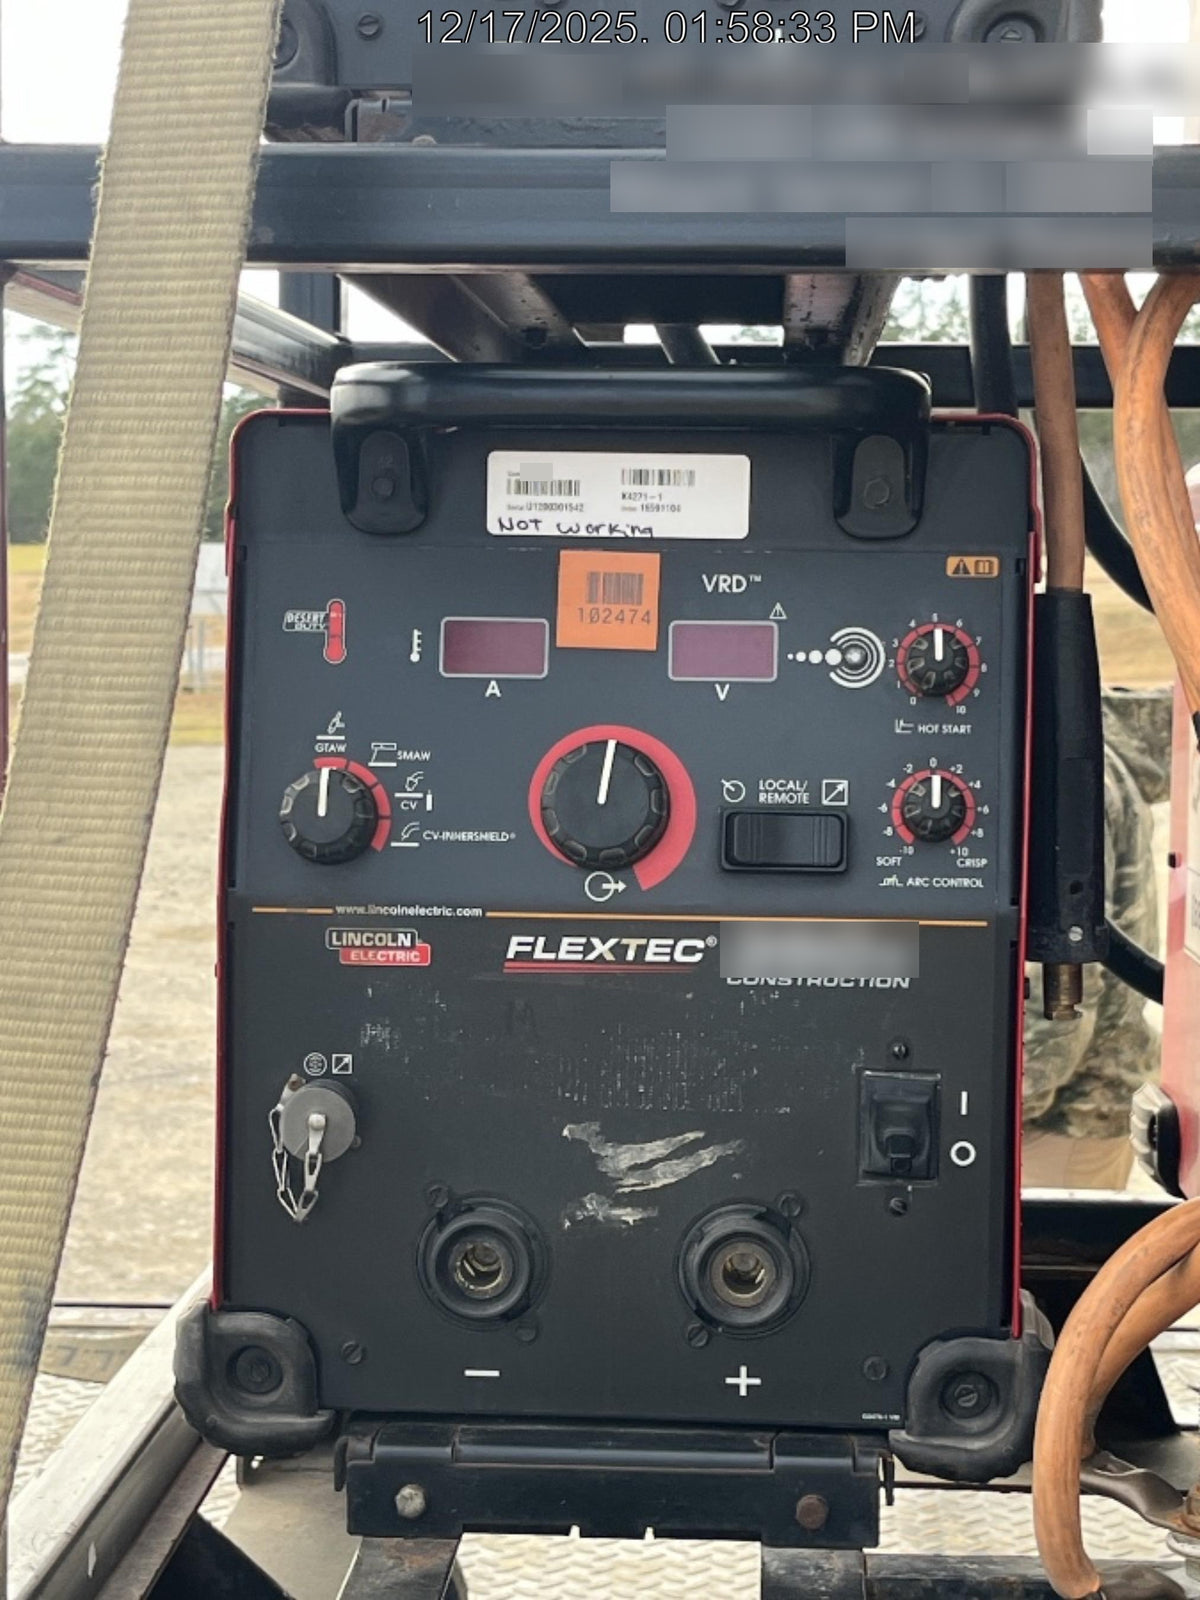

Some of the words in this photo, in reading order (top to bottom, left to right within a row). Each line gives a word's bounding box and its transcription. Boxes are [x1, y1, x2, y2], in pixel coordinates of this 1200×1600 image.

[287, 612, 325, 623] DESERT
[577, 607, 651, 624] 102474
[931, 612, 939, 623] 5
[294, 622, 326, 631] DUTY
[908, 618, 917, 629] 4
[955, 618, 964, 629] 6
[891, 638, 899, 648] 3
[975, 636, 983, 646] 7
[888, 658, 896, 669] 2
[980, 662, 989, 673] 8
[484, 680, 502, 698] A
[714, 683, 730, 701] V
[972, 688, 981, 699] 9
[909, 696, 918, 706] 0
[955, 704, 967, 715] 10
[917, 724, 939, 735] HOT
[942, 724, 973, 735] START
[314, 743, 348, 754] GTAW
[396, 750, 431, 761] SMAW
[929, 757, 938, 768] 0
[902, 763, 914, 774] -2
[949, 764, 963, 774] +2
[758, 779, 809, 792] LOCAL/
[885, 778, 896, 787] -4
[968, 780, 982, 790] +4
[758, 792, 810, 805] REMOTE
[400, 800, 418, 811] CV
[877, 803, 888, 814] -6
[950, 847, 969, 857] +10
[876, 856, 902, 867] SOFT
[956, 858, 988, 869] CRISP
[906, 877, 930, 888] ARC
[932, 877, 985, 889] CONTROL
[335, 903, 483, 918] www.lincolnelectric.com
[331, 931, 412, 947] LINCOLN
[350, 950, 421, 963] ELECTRIC
